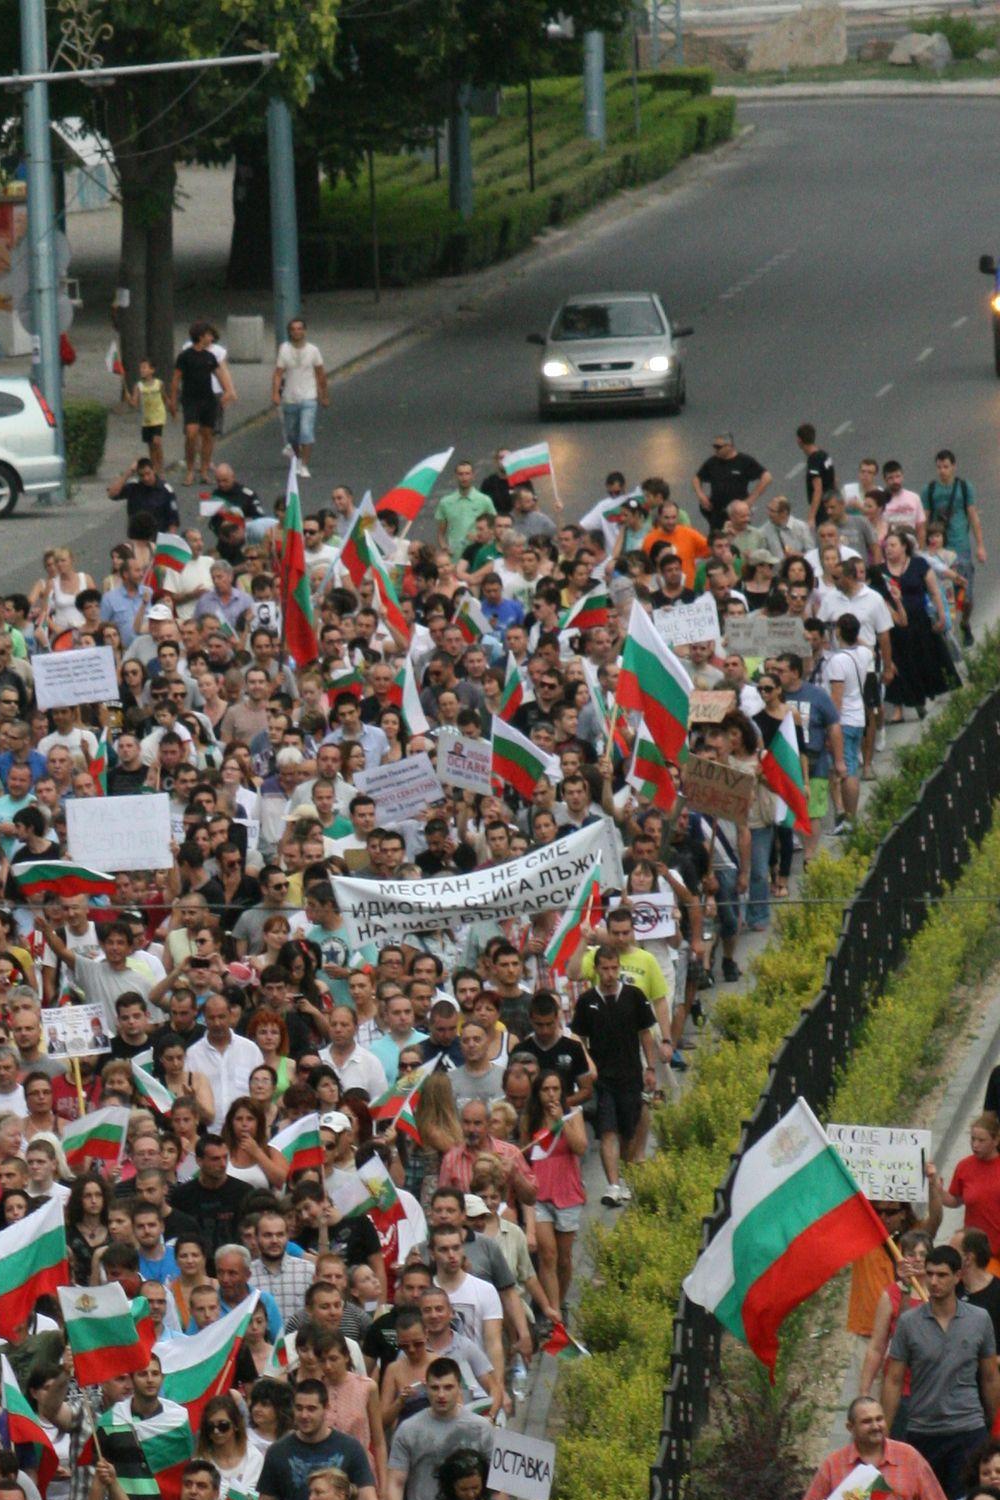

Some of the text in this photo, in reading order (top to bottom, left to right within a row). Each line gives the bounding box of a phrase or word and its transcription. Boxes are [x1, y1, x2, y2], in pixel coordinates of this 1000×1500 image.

[378, 878, 471, 898] МЕСТАН
[490, 863, 520, 884] НЕ
[524, 839, 570, 870] СМЕ
[351, 900, 444, 921] ИДИОТИ
[463, 878, 534, 910] СТИГА
[357, 922, 388, 942] НА
[851, 1129, 881, 1144] ONE
[888, 1130, 919, 1146] HAS
[493, 1447, 552, 1483] ОСТАВКА
